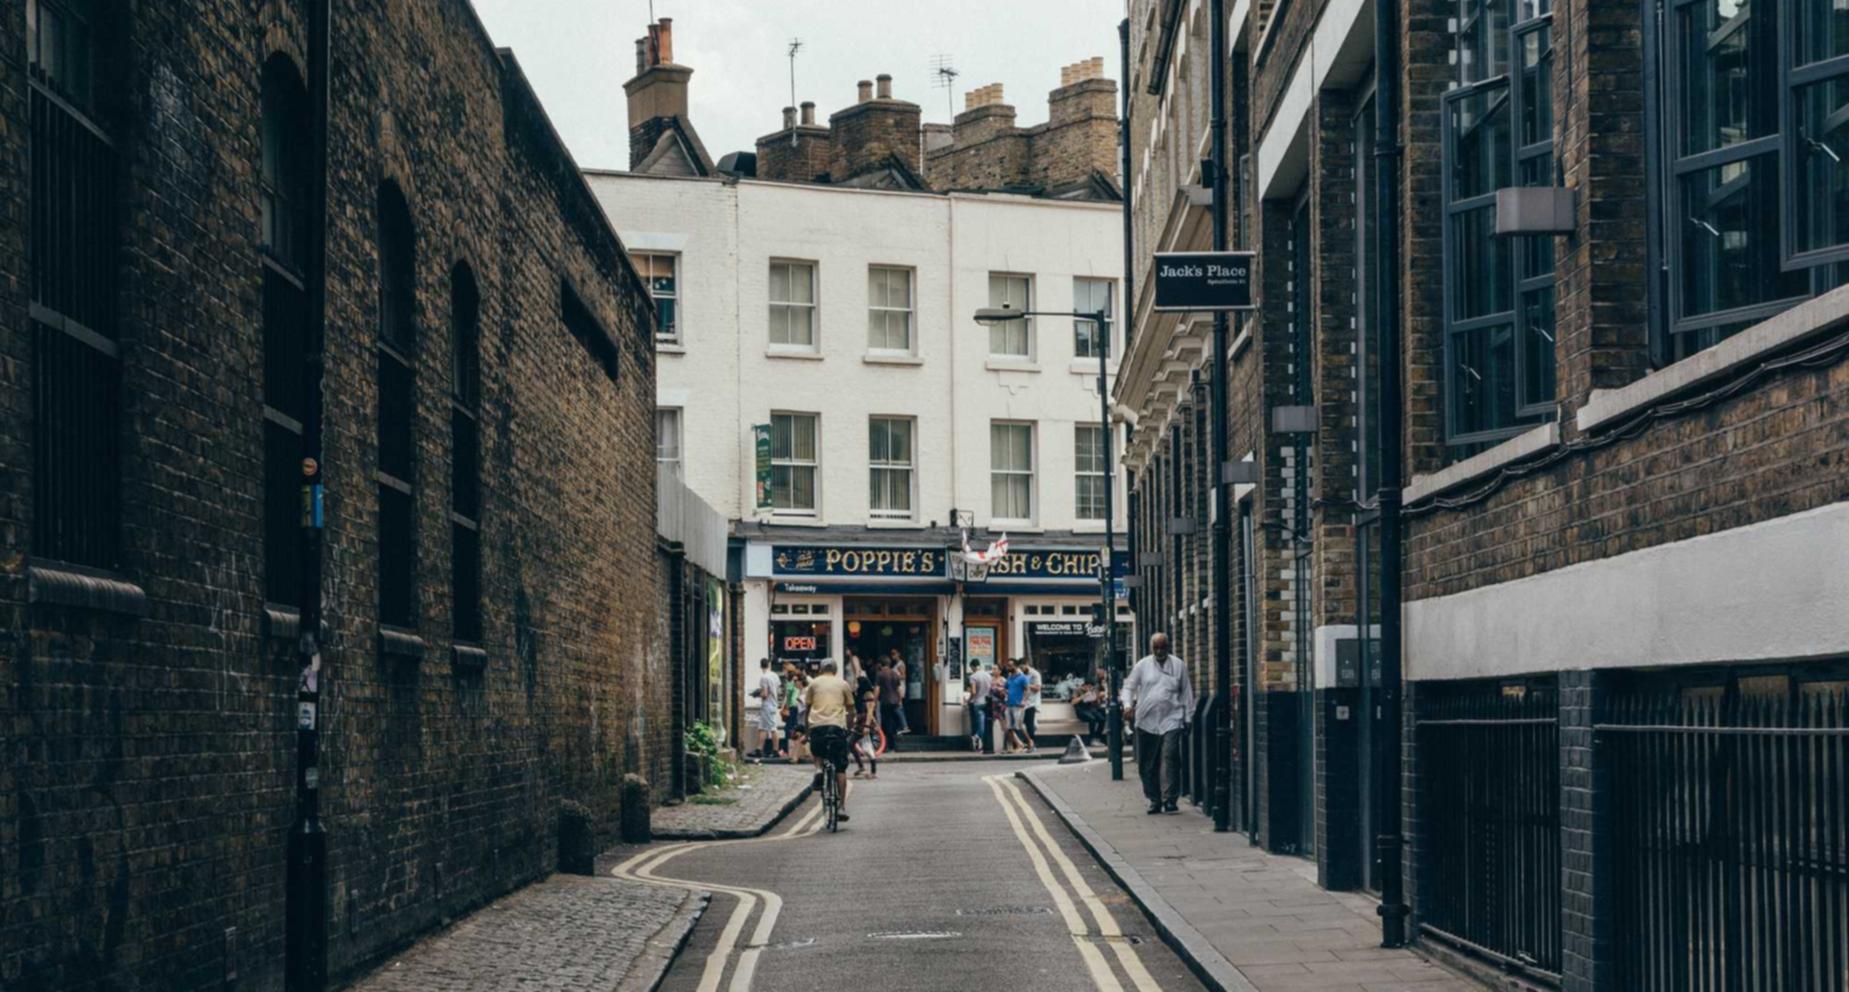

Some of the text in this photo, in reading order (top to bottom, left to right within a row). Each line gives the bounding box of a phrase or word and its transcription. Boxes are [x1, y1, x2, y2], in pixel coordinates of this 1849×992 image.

[1160, 265, 1246, 277] Jack's Place
[826, 549, 934, 572] POPPIE'S
[989, 552, 1101, 575] SH & CHIP
[784, 583, 817, 593] Takeaway
[1036, 623, 1071, 631] WELCOME
[1072, 623, 1083, 631] TO
[784, 636, 817, 650] OPEN
